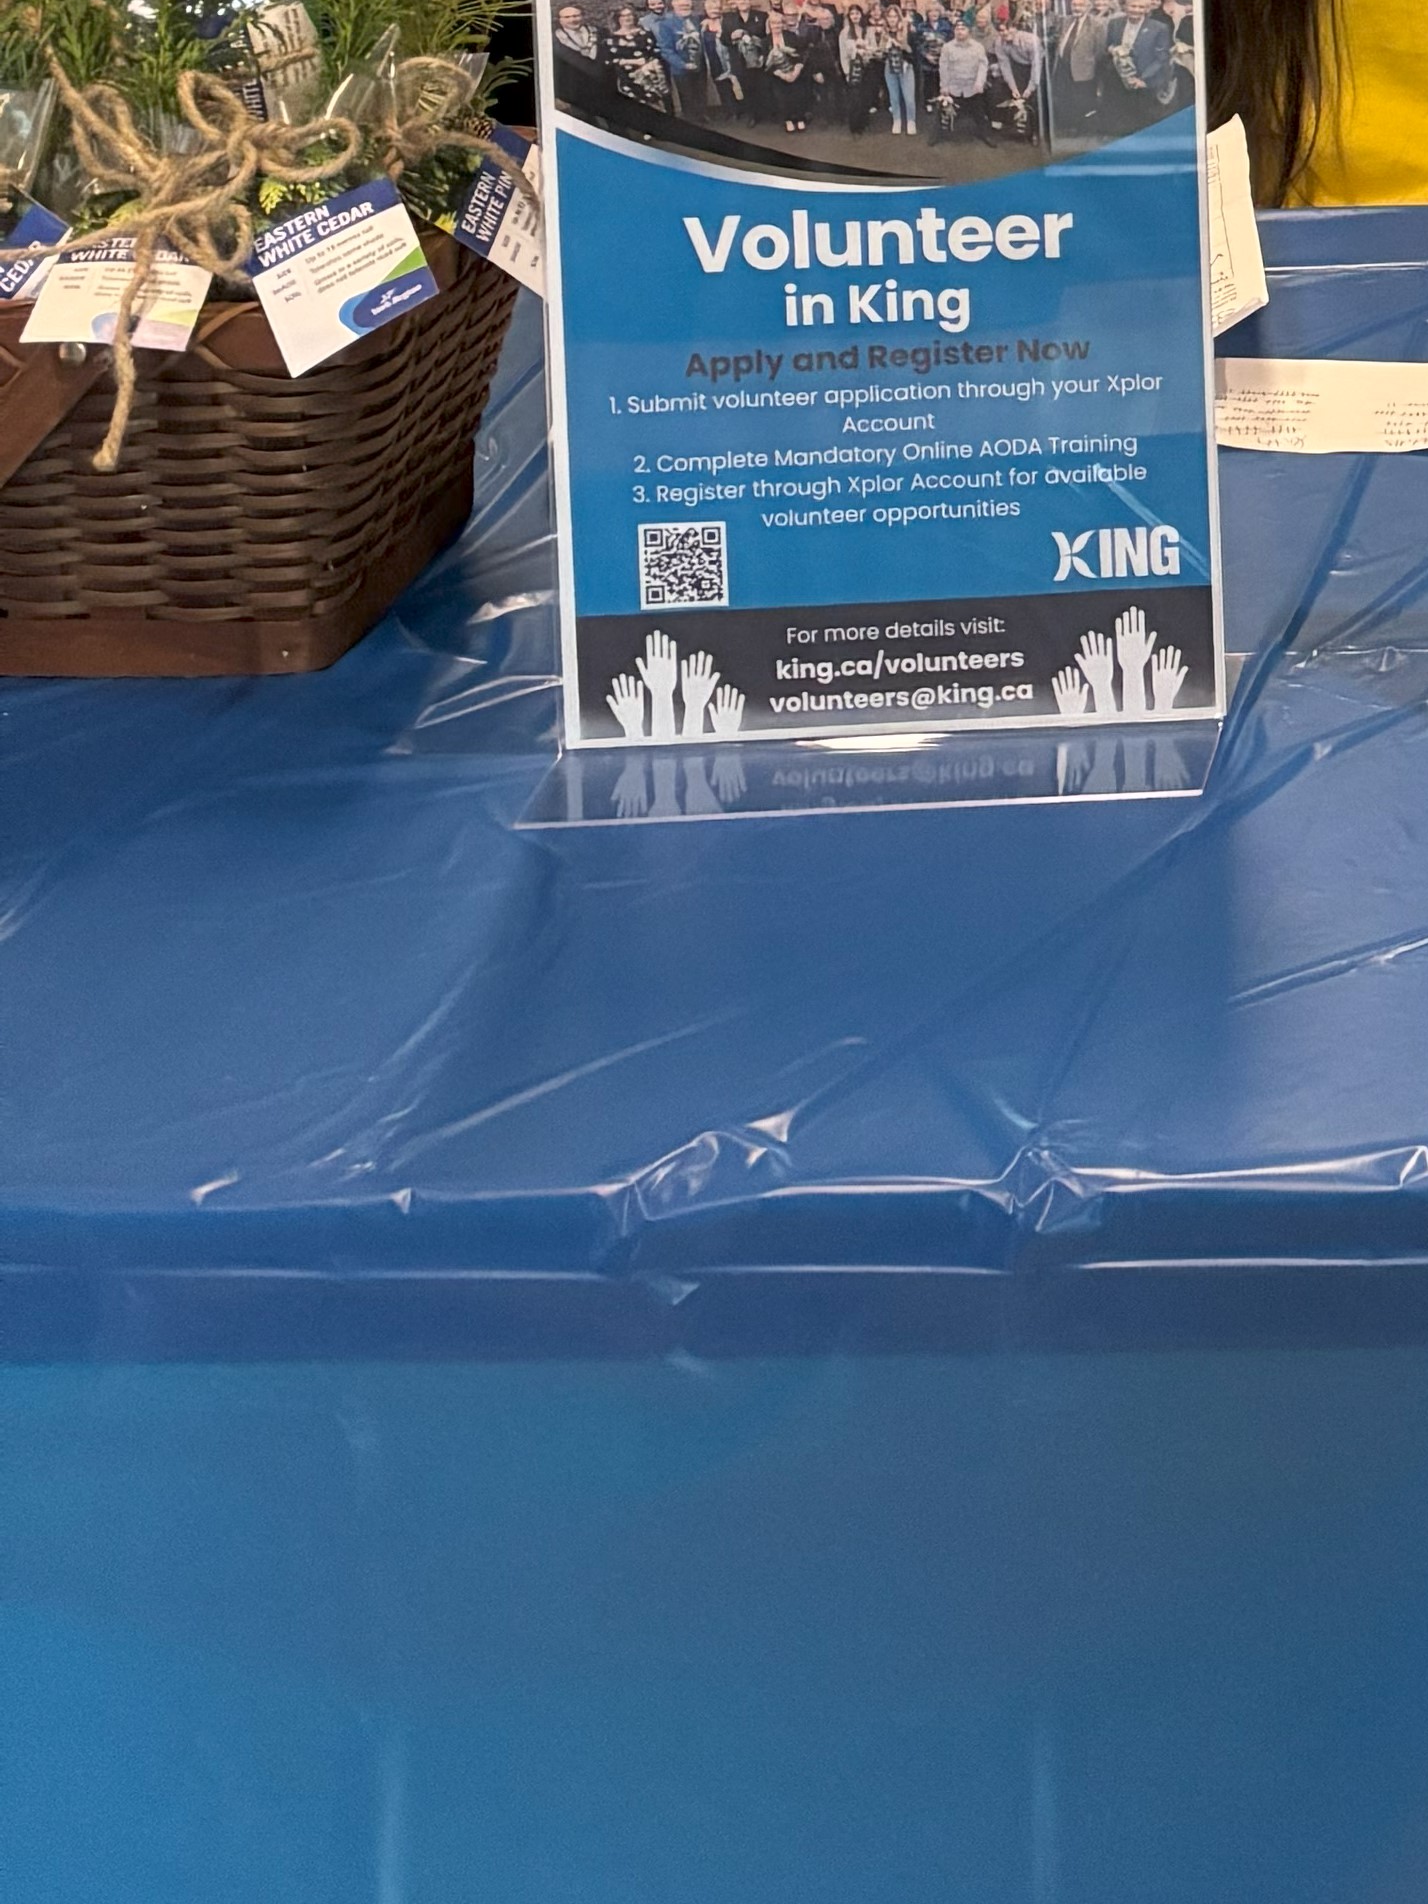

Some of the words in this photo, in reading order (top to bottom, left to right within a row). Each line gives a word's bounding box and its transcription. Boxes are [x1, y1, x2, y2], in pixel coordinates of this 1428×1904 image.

[460, 170, 498, 235] EASTERN
[475, 195, 504, 243] WHITE
[254, 204, 331, 255] EASTERN
[257, 228, 316, 269] WHITE
[316, 201, 376, 237] CEDAR
[683, 207, 1074, 273] Volunteer
[70, 247, 128, 263] WHITE
[784, 283, 835, 327] in
[848, 278, 970, 333] King
[685, 349, 784, 384] Apply
[792, 344, 860, 372] and
[867, 339, 1009, 375] Register
[1016, 338, 1090, 363] Now
[609, 396, 622, 415] 1.
[627, 392, 707, 414] Submit
[712, 390, 818, 409] volunteer
[824, 384, 951, 409] application
[957, 377, 1045, 402] through
[1051, 379, 1100, 401] your
[1107, 373, 1163, 397] Xplor
[842, 413, 935, 433] Account
[633, 454, 651, 473] 2.
[656, 450, 769, 476] Complete
[774, 446, 897, 468] Mandatory
[902, 440, 973, 461] Online
[979, 437, 1043, 458] AODA
[1047, 433, 1138, 457] Training
[632, 485, 651, 504] 3.
[656, 482, 746, 507] Register
[752, 476, 841, 501] through
[847, 474, 904, 499] Xplor
[910, 470, 1003, 491] Account
[1008, 467, 1038, 486] for
[1044, 462, 1147, 488] available
[761, 508, 867, 527] volunteer
[872, 499, 1021, 527] opportunities
[1051, 524, 1181, 582] KING
[786, 627, 818, 644] For
[824, 626, 880, 642] more
[885, 619, 956, 639] details
[960, 616, 1006, 635] visit:
[776, 649, 1025, 684] king.ca/volunteers
[769, 682, 1034, 718] volunteers@king.ca
